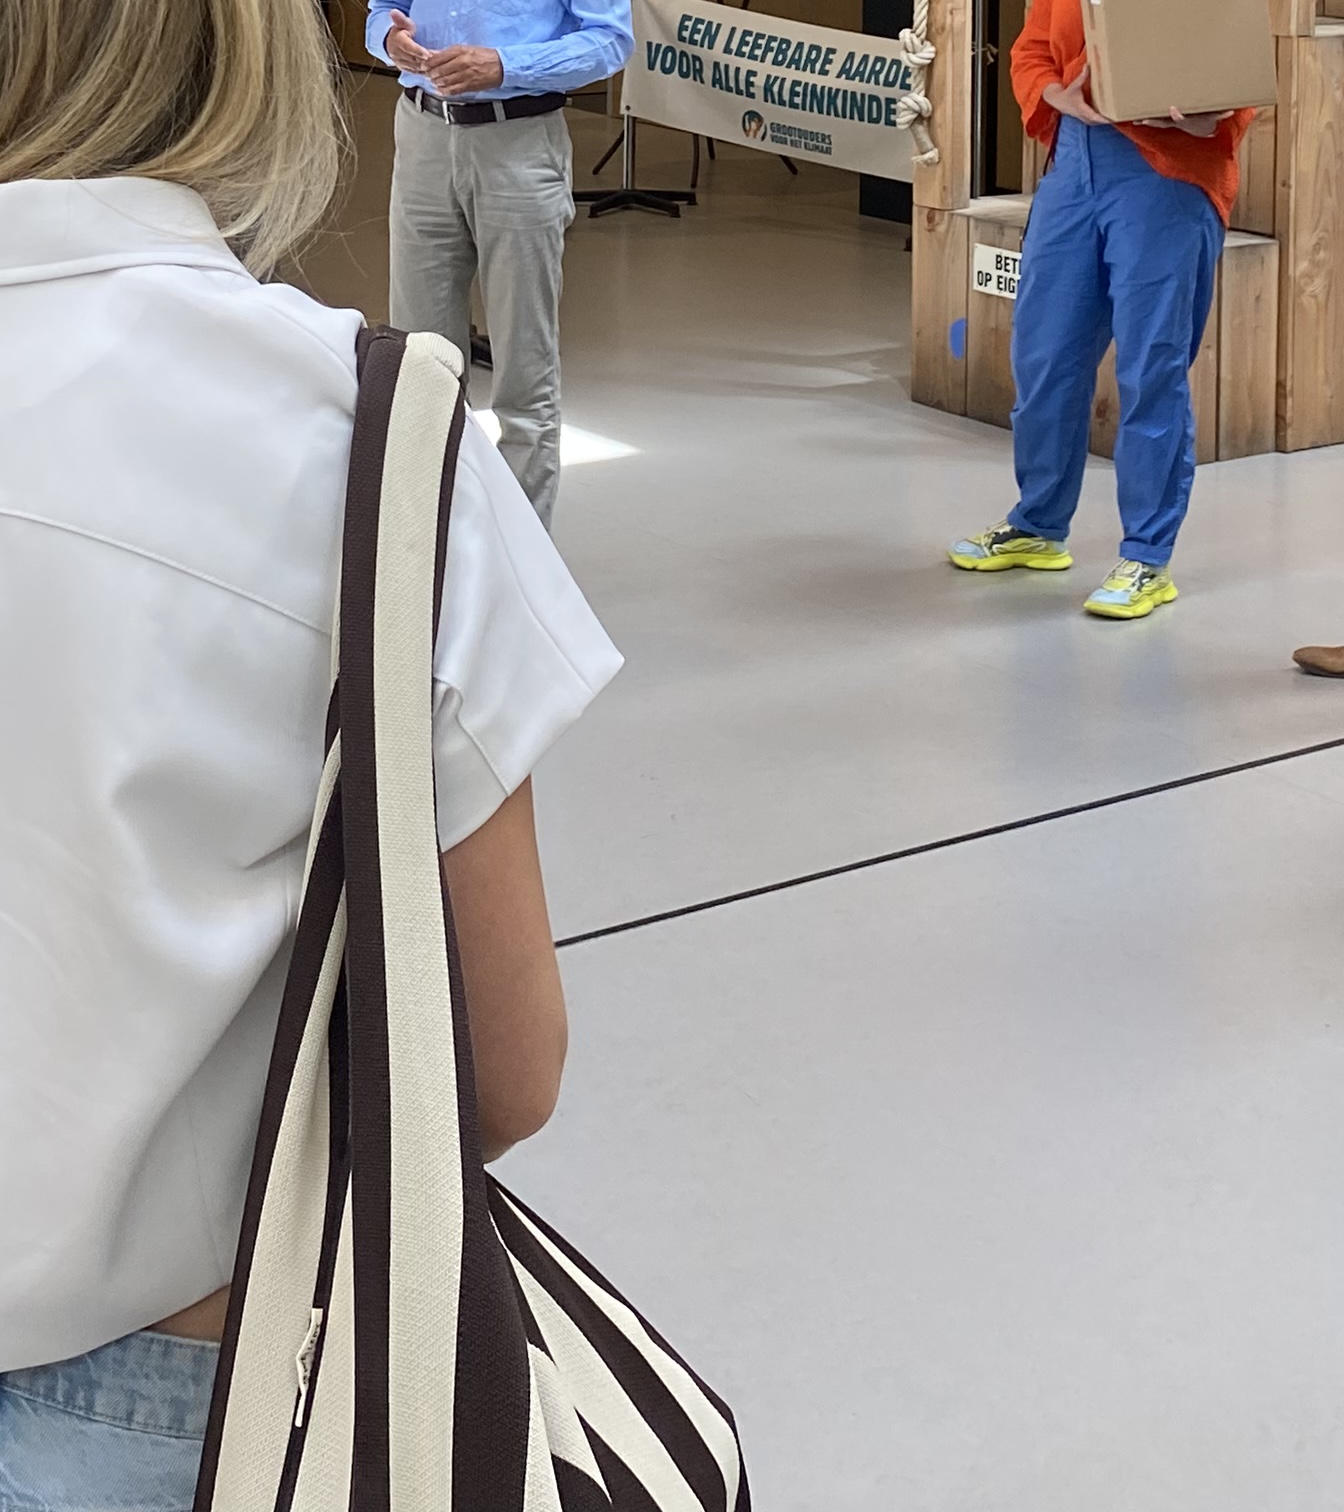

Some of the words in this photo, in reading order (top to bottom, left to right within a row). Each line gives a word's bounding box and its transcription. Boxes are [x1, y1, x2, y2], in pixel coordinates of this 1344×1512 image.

[647, 41, 704, 84] VOOR
[712, 61, 757, 99] ALLE
[677, 14, 722, 50] EEN
[723, 27, 837, 76] LEEFBARE
[836, 52, 912, 91] AARDE
[977, 270, 992, 287] OP
[997, 275, 1020, 293] EIG
[996, 254, 1021, 275] BET
